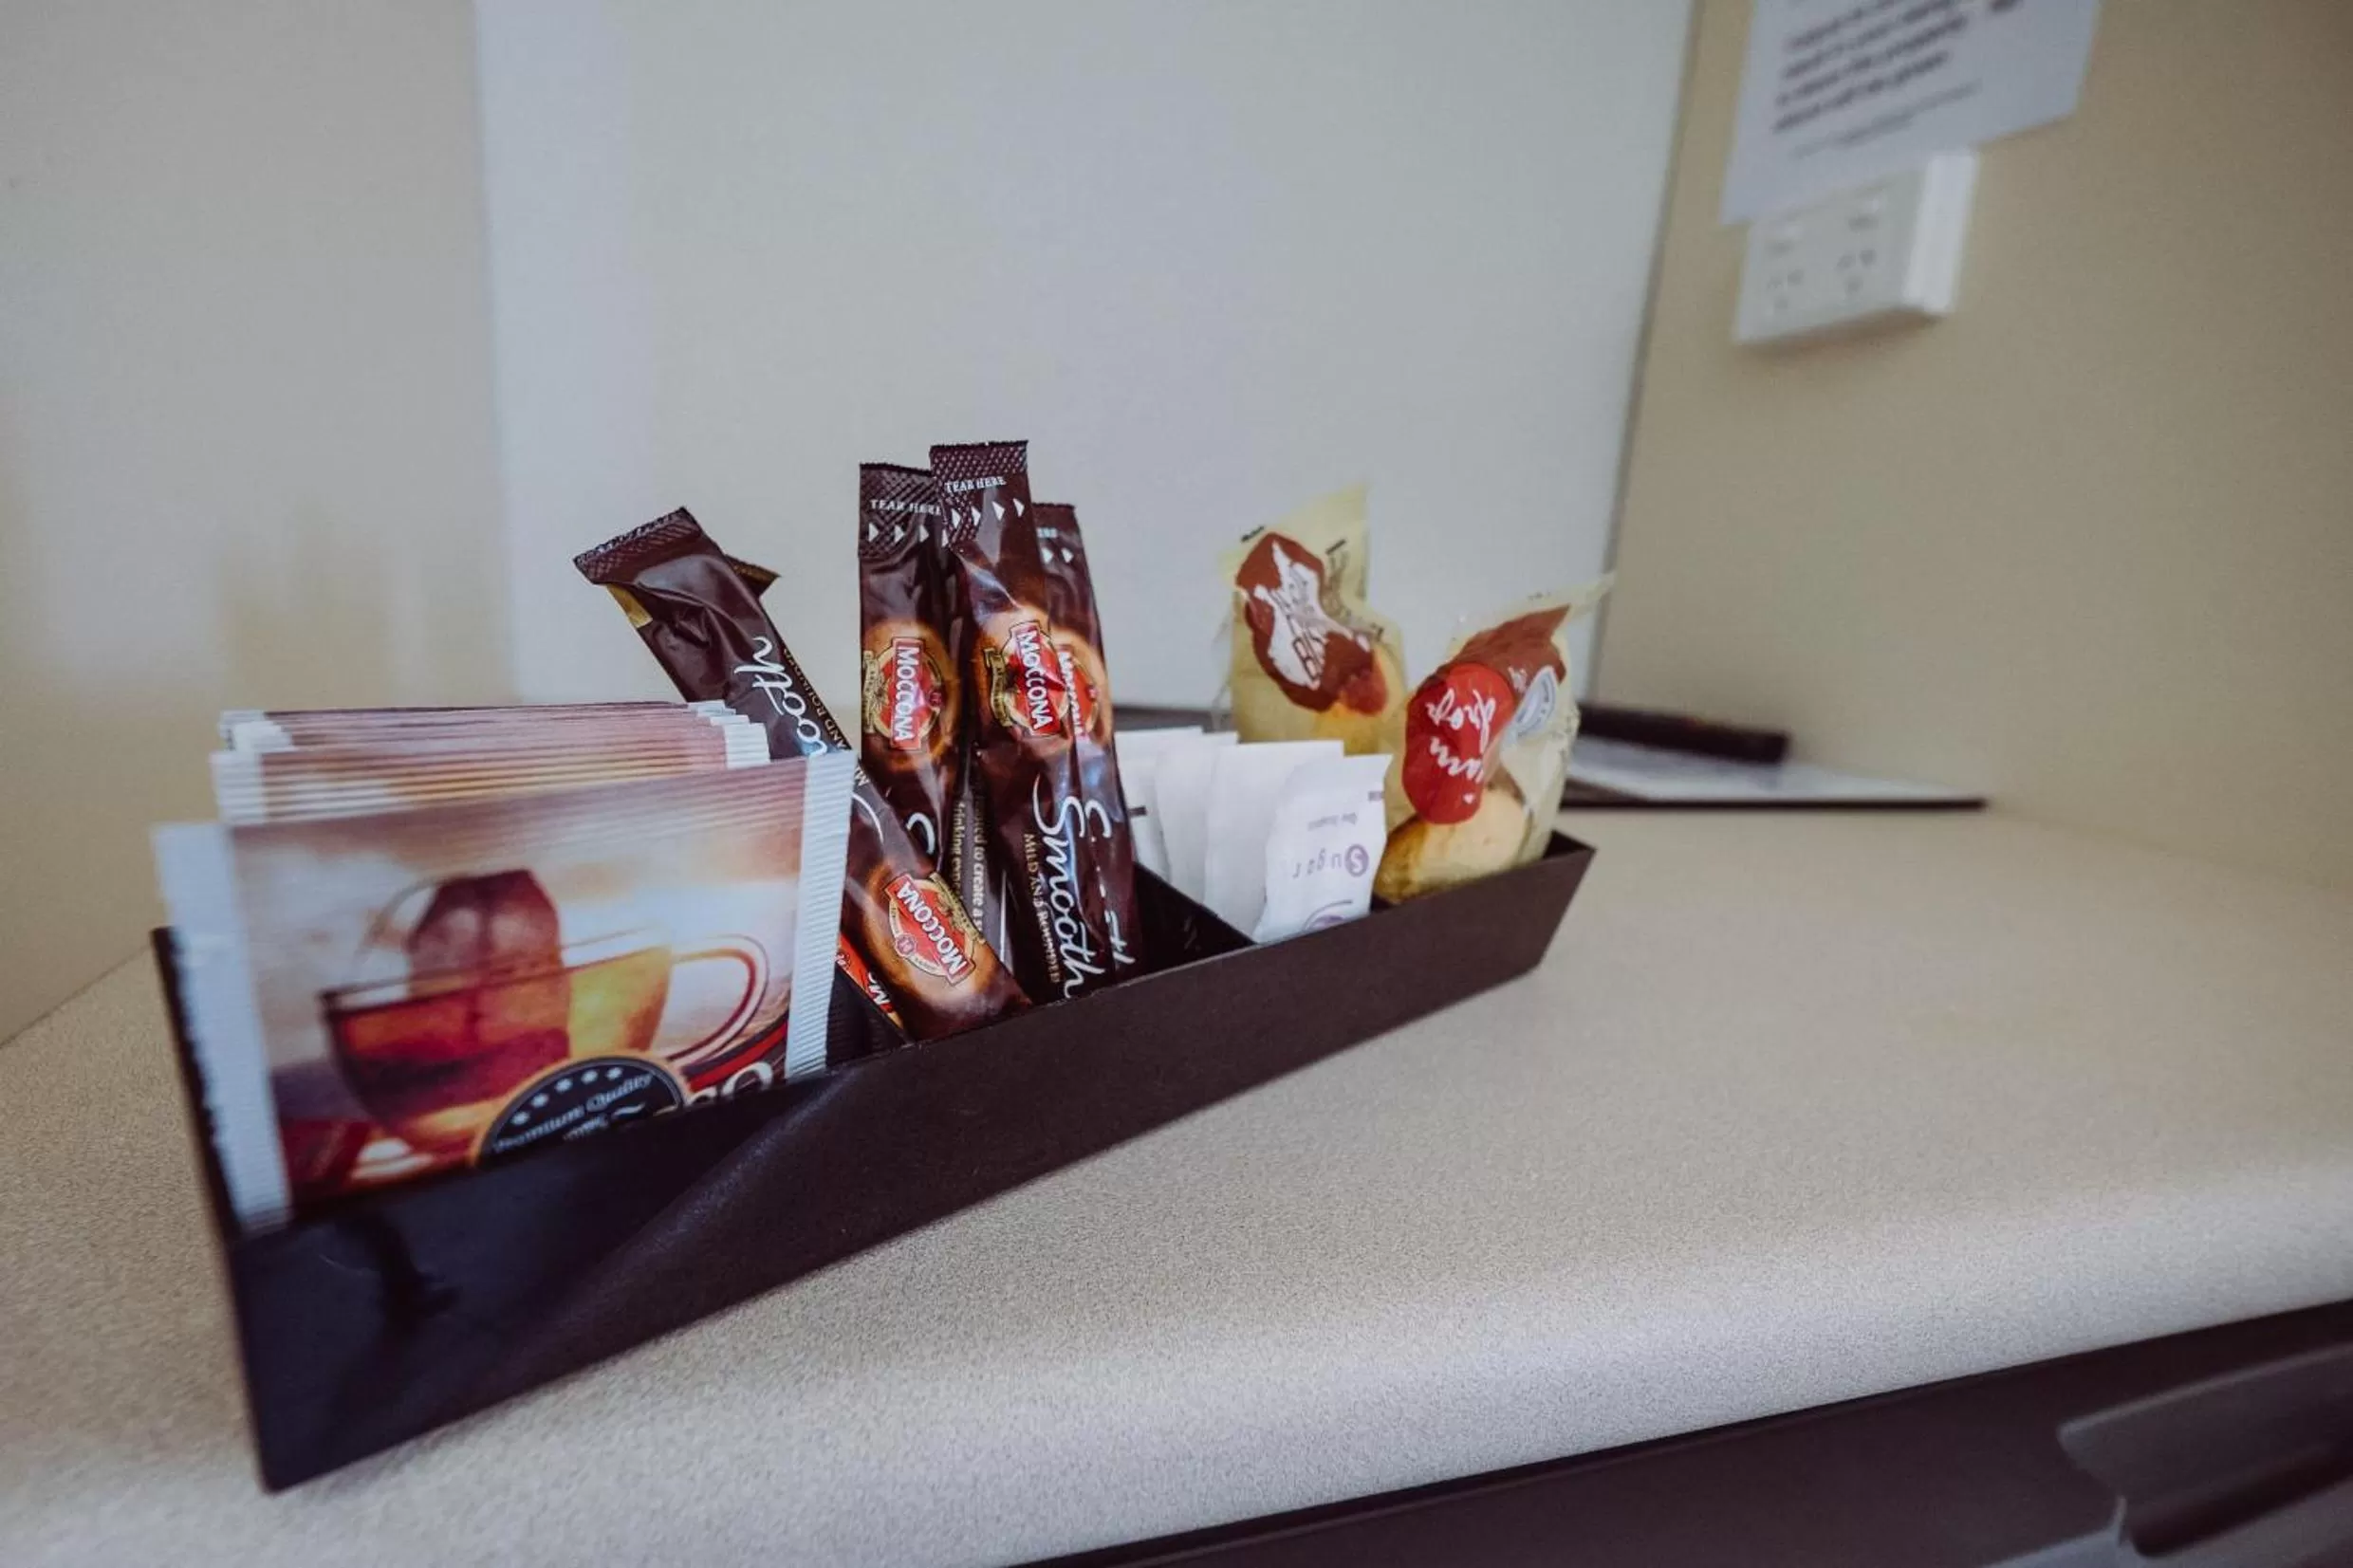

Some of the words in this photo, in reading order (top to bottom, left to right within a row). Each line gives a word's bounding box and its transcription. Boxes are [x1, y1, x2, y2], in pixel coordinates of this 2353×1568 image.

[870, 499, 905, 511] TEAR
[945, 478, 974, 493] TEAR
[976, 476, 1007, 489] HERE
[734, 636, 827, 757] ooth
[893, 646, 920, 743] MOCCONA
[1017, 629, 1054, 730] MOCCONA
[973, 846, 986, 861] to
[973, 864, 985, 907] create
[1024, 833, 1039, 873] MILD
[1033, 773, 1105, 999] Smooth
[896, 880, 968, 975] MOCCONA
